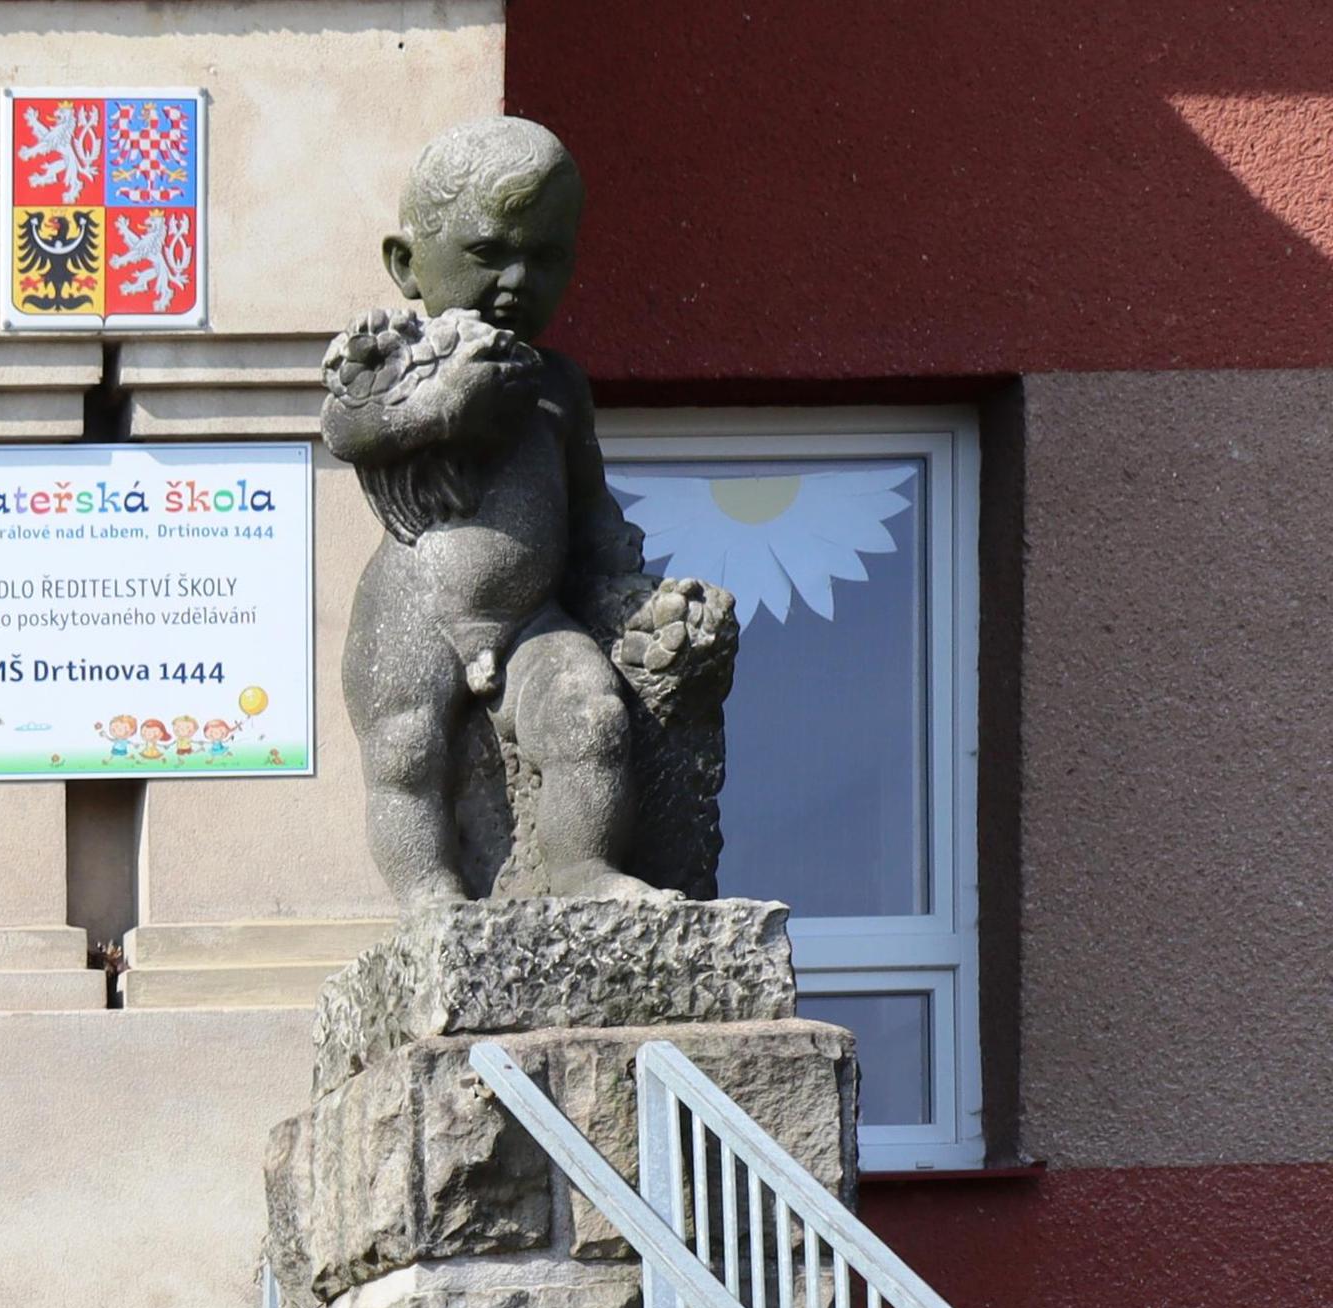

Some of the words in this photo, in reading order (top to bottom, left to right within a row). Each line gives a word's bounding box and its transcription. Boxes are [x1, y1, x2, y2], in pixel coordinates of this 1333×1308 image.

[165, 479, 276, 513] škola
[56, 524, 84, 539] nad
[90, 523, 149, 540] Labem,
[158, 523, 229, 539] Drtinova
[234, 525, 274, 539] 1444
[41, 573, 171, 600] ŘEDITELSTVÍ
[177, 572, 238, 598] ŠKOLY
[17, 607, 156, 632] poskytovaného
[161, 605, 257, 626] vzdělávání
[33, 658, 151, 682] Drtinova
[159, 661, 225, 684] 1444
